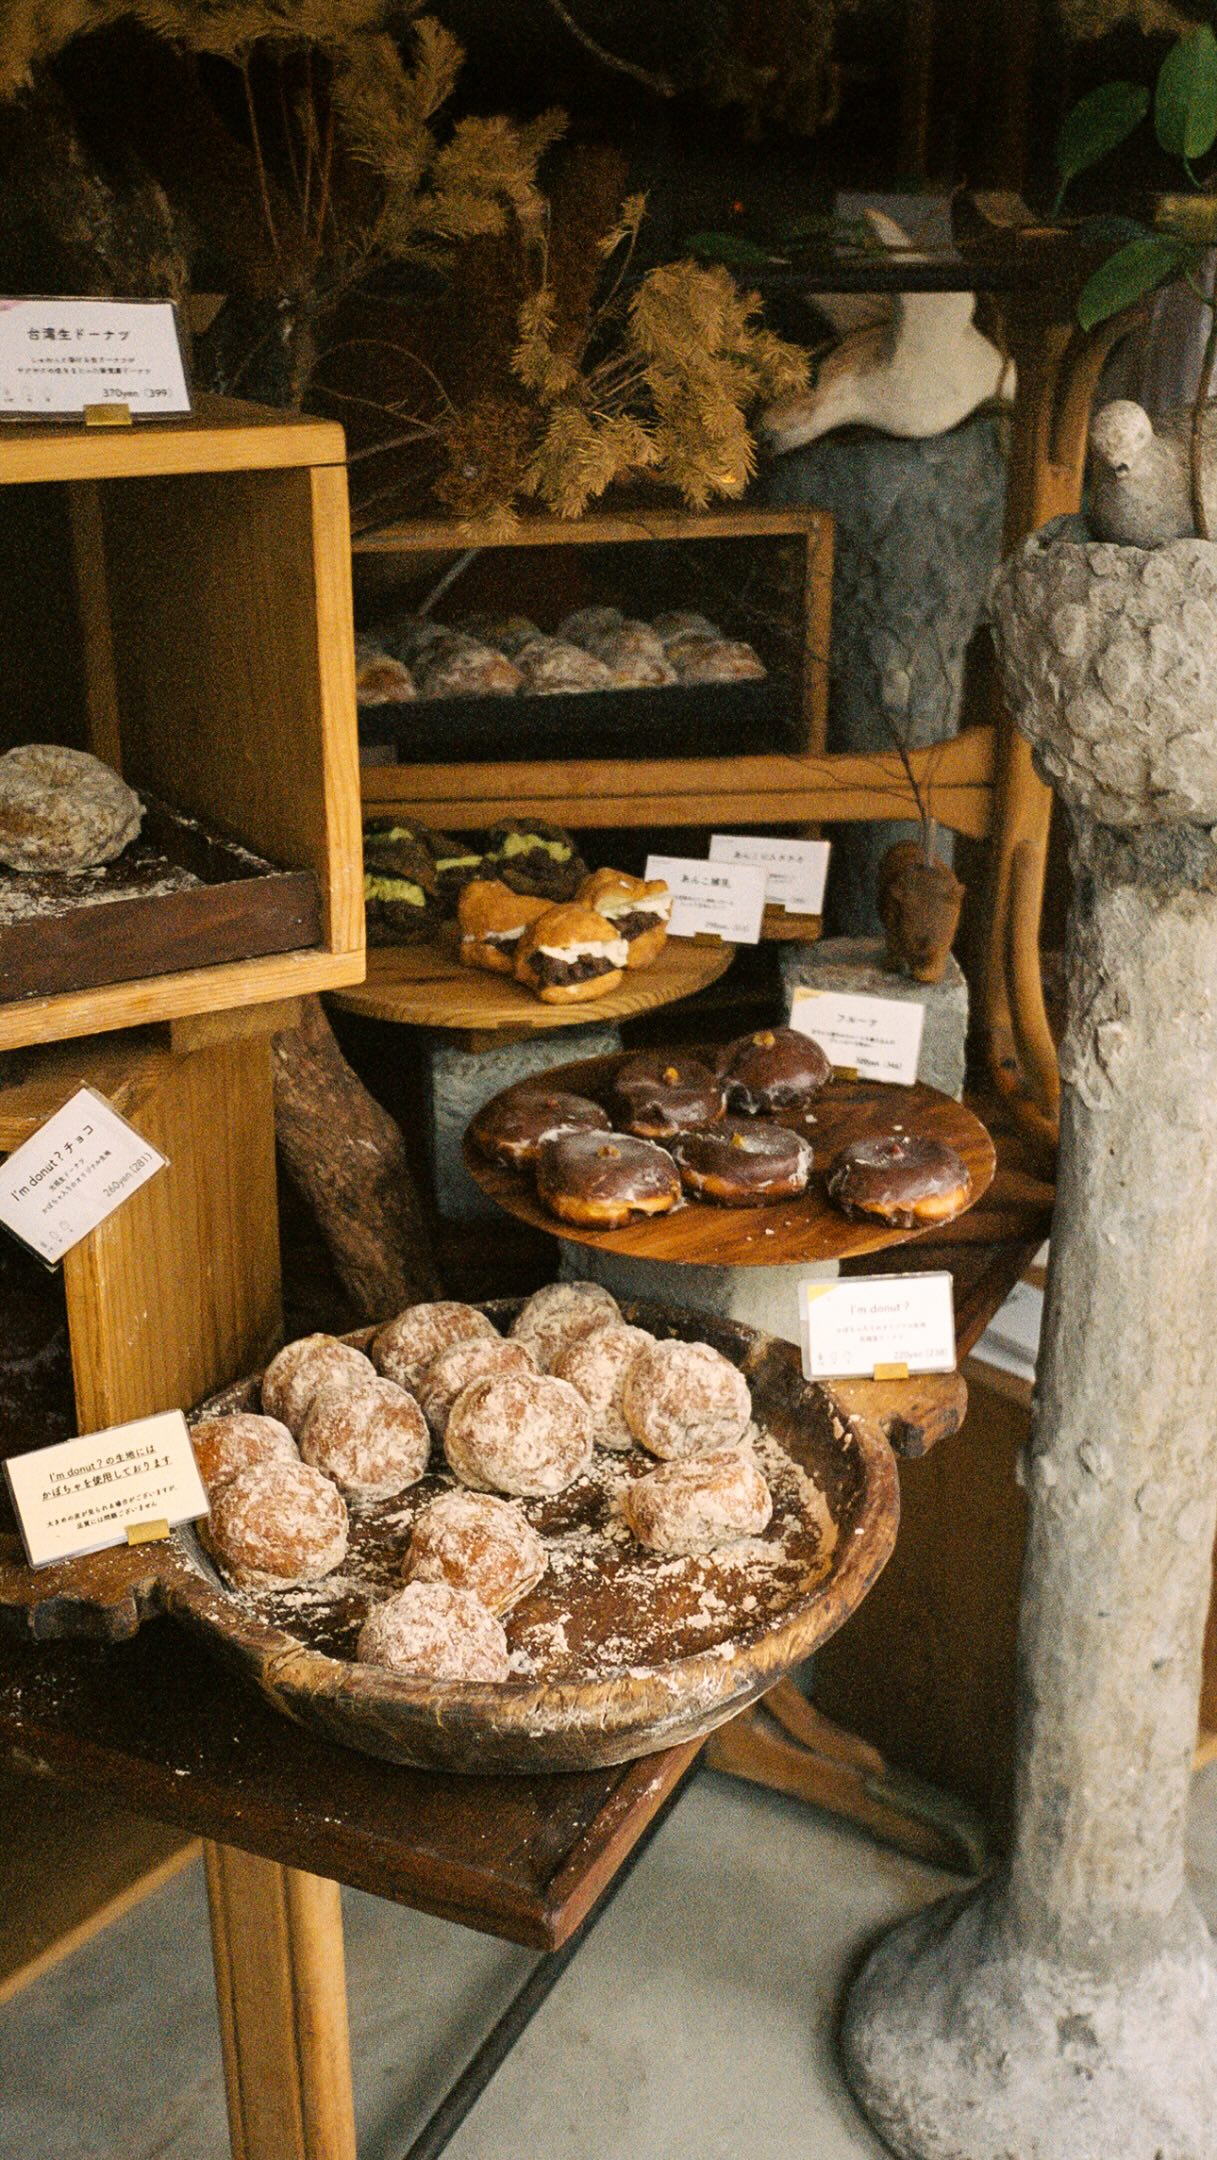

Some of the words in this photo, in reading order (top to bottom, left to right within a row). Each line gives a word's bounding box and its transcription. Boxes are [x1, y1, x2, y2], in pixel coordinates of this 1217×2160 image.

[27, 327, 130, 341] 台湾生ドーナツ
[103, 388, 139, 400] 370yen
[11, 1186, 31, 1202] I'm
[29, 1159, 59, 1187] donut
[64, 1125, 94, 1154] チョコ
[102, 1172, 132, 1198] 260yen
[129, 1152, 153, 1175] (281)
[851, 1304, 866, 1315] I'm
[870, 1303, 901, 1314] donut
[42, 1455, 172, 1500] かぼちゃを使用しております
[49, 1472, 65, 1482] I'm
[67, 1463, 96, 1477] donut
